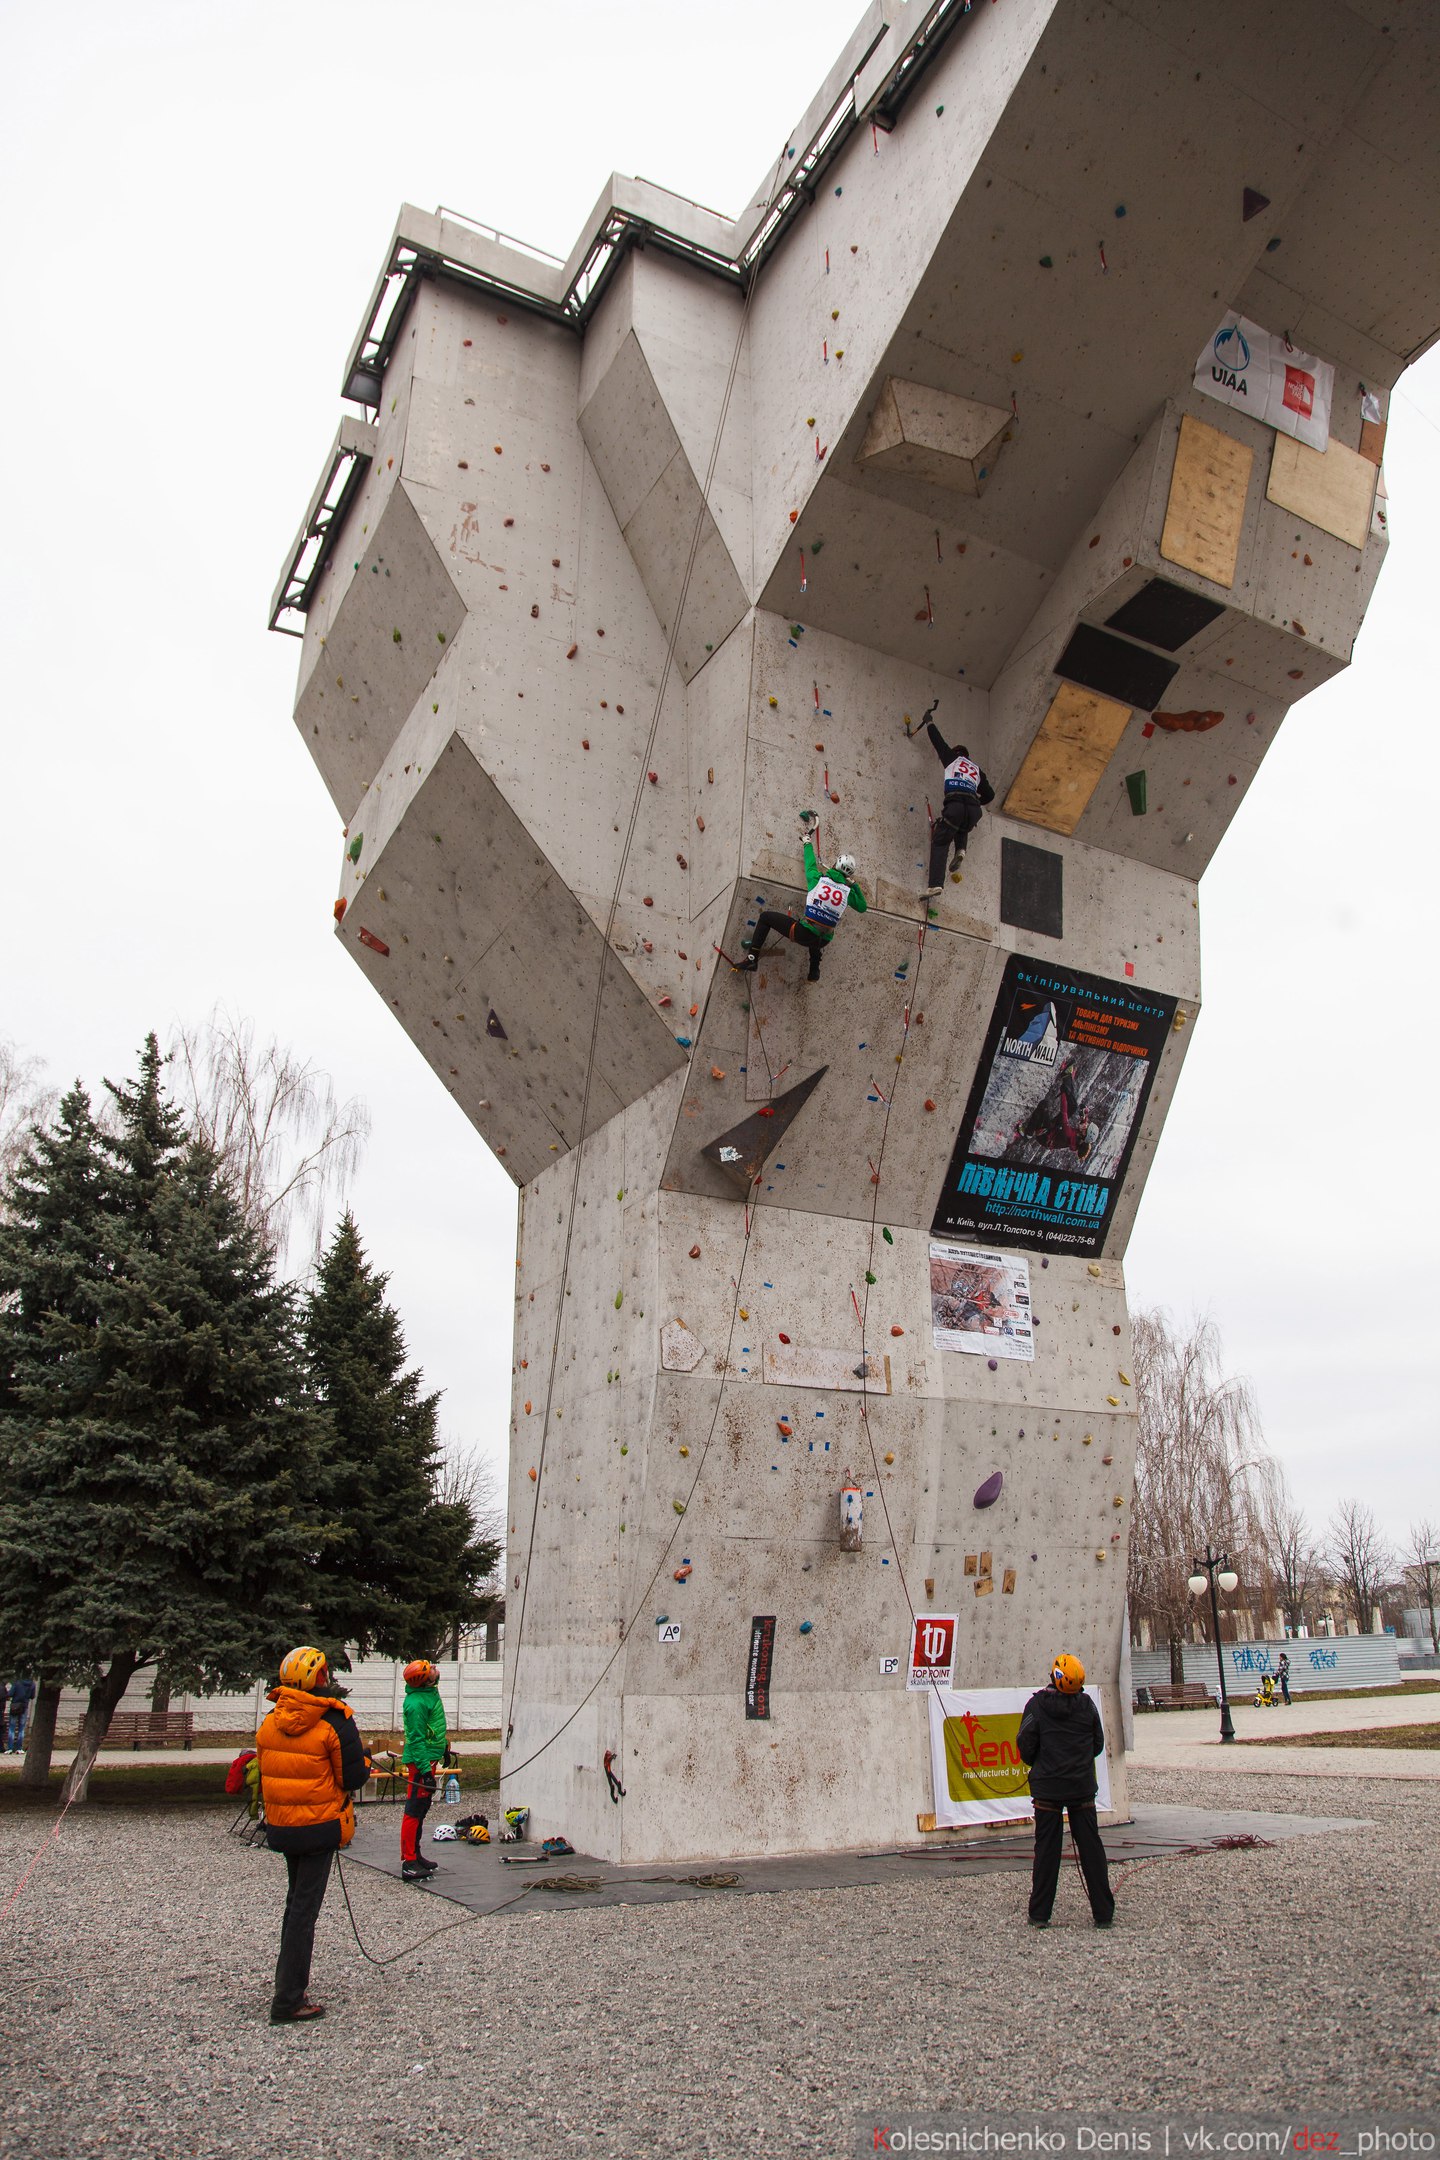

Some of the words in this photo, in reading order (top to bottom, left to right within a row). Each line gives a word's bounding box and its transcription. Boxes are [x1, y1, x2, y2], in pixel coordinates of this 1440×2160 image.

[1212, 366, 1247, 396] UIAA
[958, 760, 977, 781] 52
[818, 885, 843, 907] 39
[1017, 972, 1125, 1007] екіпірувальний
[1128, 1001, 1165, 1018] центр
[1072, 1019, 1110, 1035] АЛЬПІНІЗМУ
[1076, 1007, 1099, 1021] ТОВАРИ
[1099, 1013, 1113, 1025] ДЛЯ
[1113, 1016, 1140, 1031] ТУРИЗМУ
[1004, 1037, 1033, 1057] NORTH
[1033, 1043, 1056, 1062] WALL
[1068, 1030, 1077, 1040] ТА
[1077, 1033, 1111, 1048] АКТИВНОГО
[1112, 1041, 1148, 1057] ВІДПОЧИНКУ
[985, 1201, 1100, 1229] http://northwall.com.ua
[956, 1217, 976, 1228] Київ,
[1036, 1229, 1044, 1240] 9,
[1045, 1231, 1096, 1246] (044)222-75-68
[663, 1625, 674, 1640] A
[753, 1630, 762, 1657] ultimate
[749, 1658, 758, 1689] mountain
[757, 1620, 774, 1716] krukonogi.com
[884, 1659, 893, 1673] B
[912, 1669, 927, 1678] TOP
[928, 1669, 950, 1678] POINT
[747, 1690, 755, 1706] gear
[962, 1768, 1009, 1779] manufactured
[1011, 1768, 1021, 1777] by
